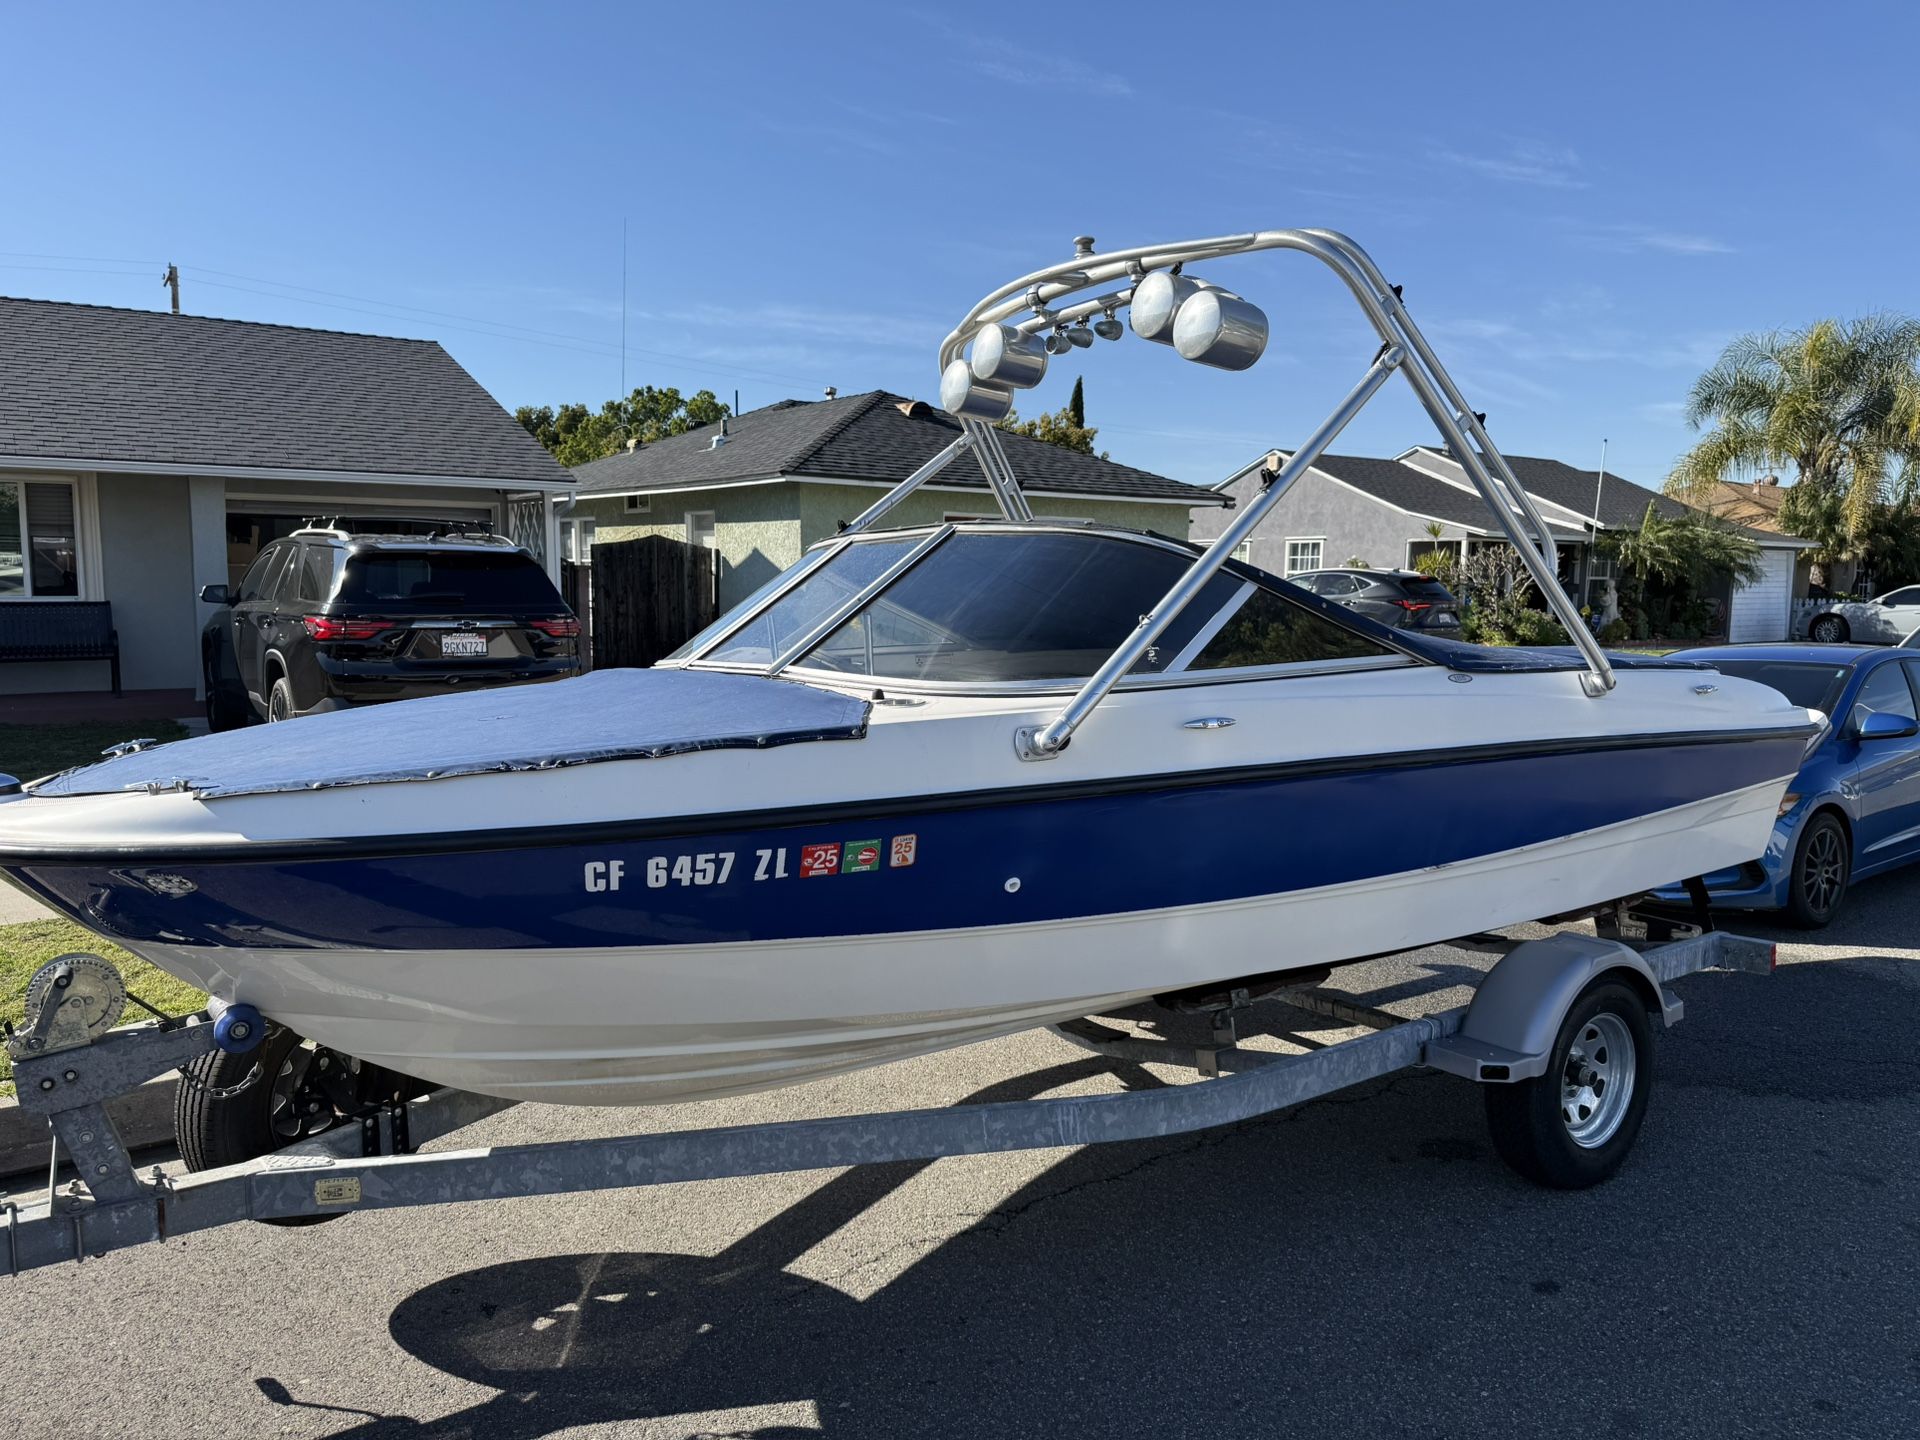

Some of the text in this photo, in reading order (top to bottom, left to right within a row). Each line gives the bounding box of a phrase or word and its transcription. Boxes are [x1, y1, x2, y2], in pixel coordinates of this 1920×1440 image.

[443, 641, 485, 653] 9GKN727
[895, 841, 913, 854] 25
[813, 849, 838, 869] 25
[584, 847, 789, 893] CF 6457 ZL
